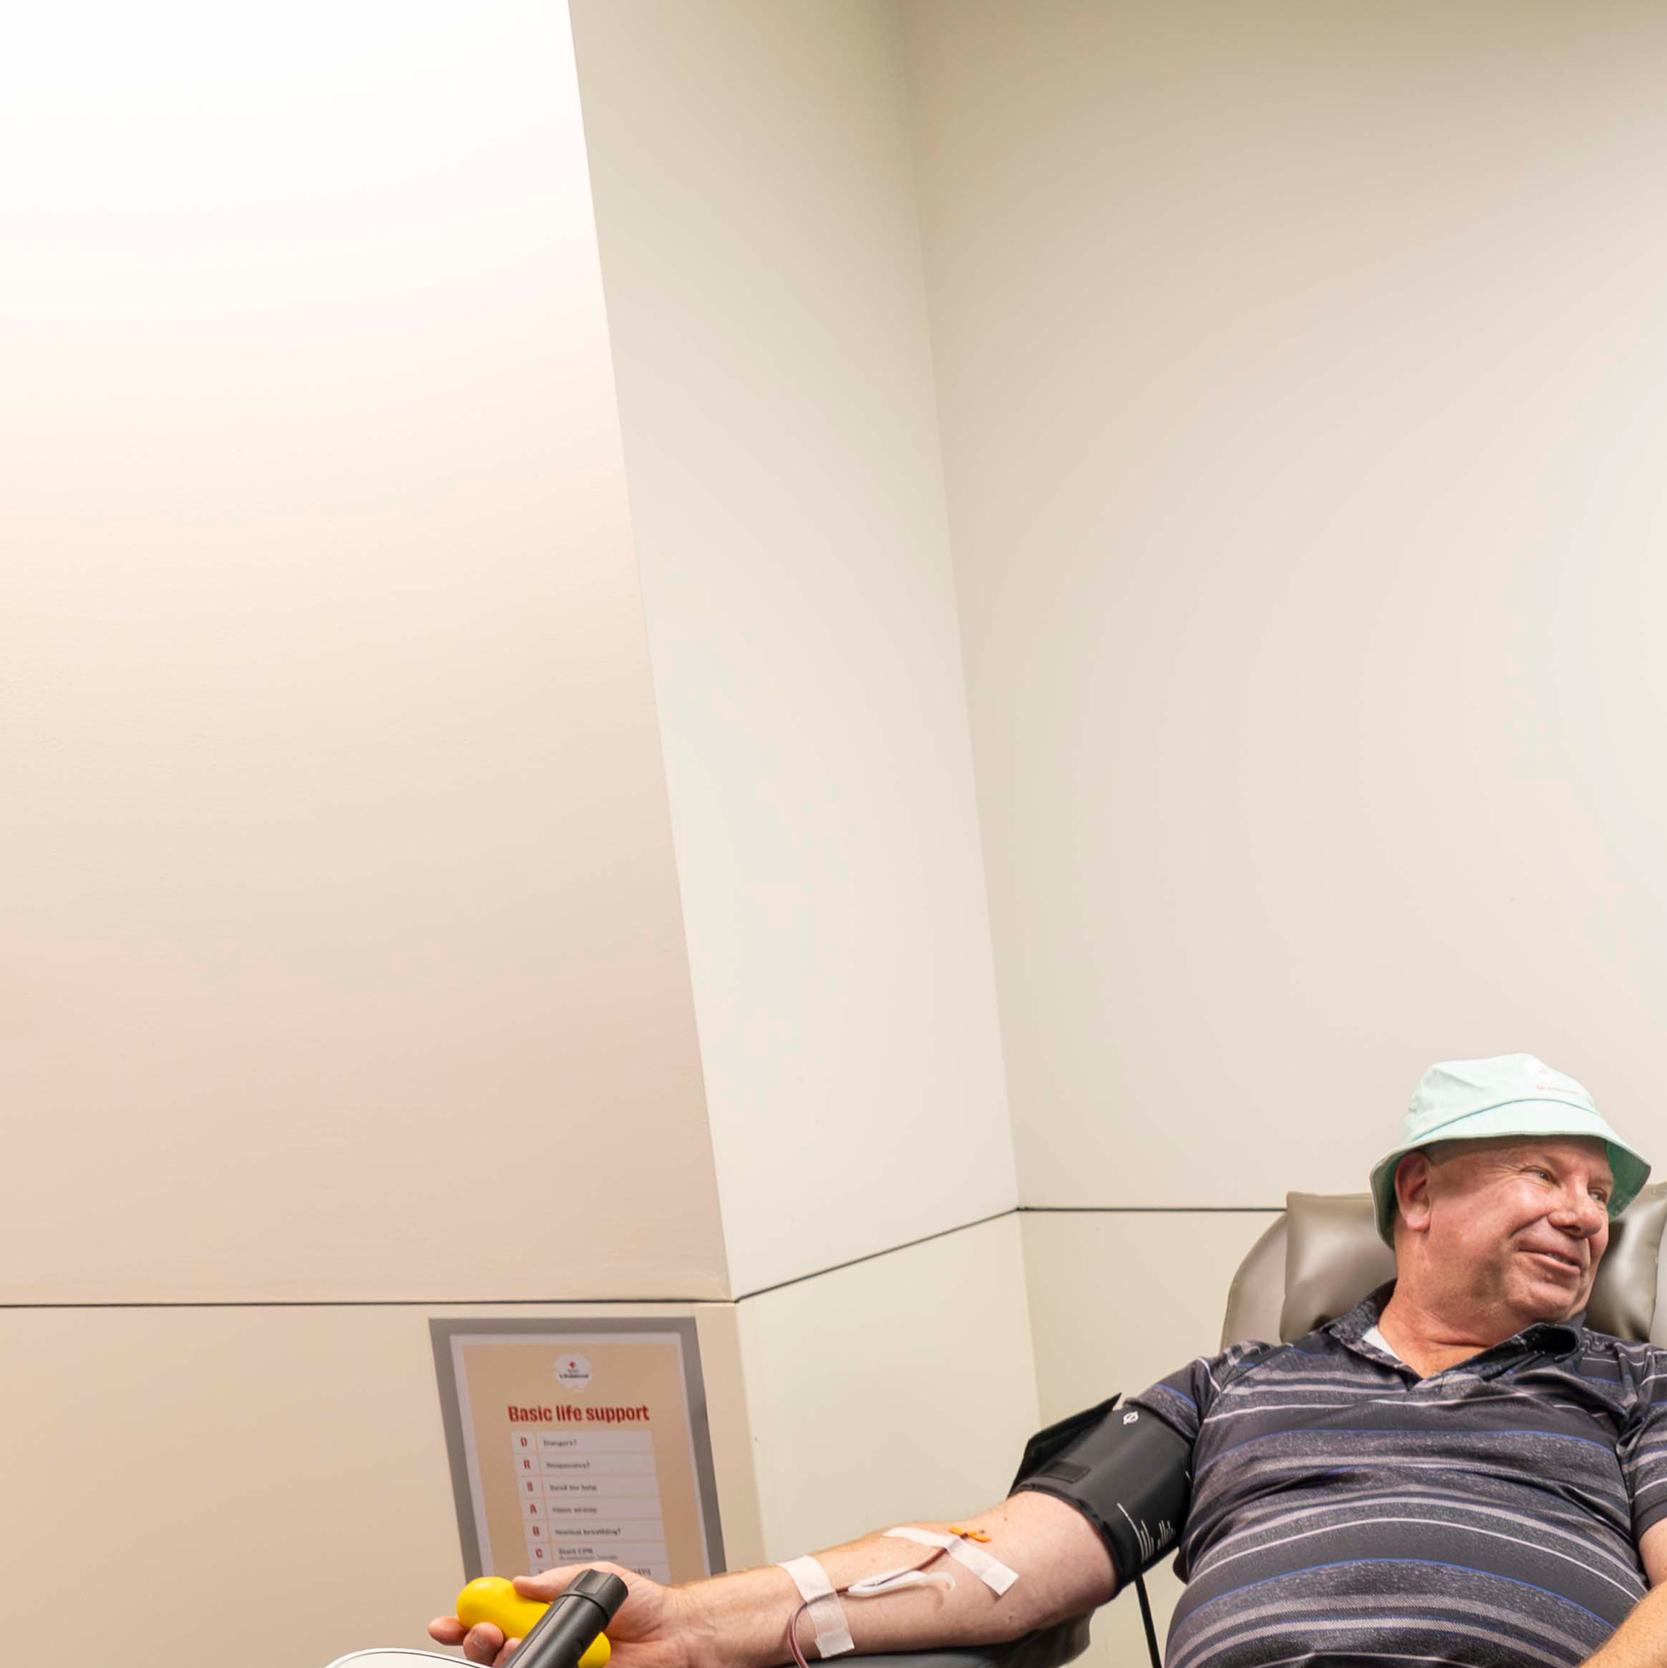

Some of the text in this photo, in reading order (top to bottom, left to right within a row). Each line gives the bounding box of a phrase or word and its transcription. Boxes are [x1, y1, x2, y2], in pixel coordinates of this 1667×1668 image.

[508, 1405, 650, 1424] Basic life support
[530, 1504, 537, 1514] A
[535, 1549, 543, 1558] C
